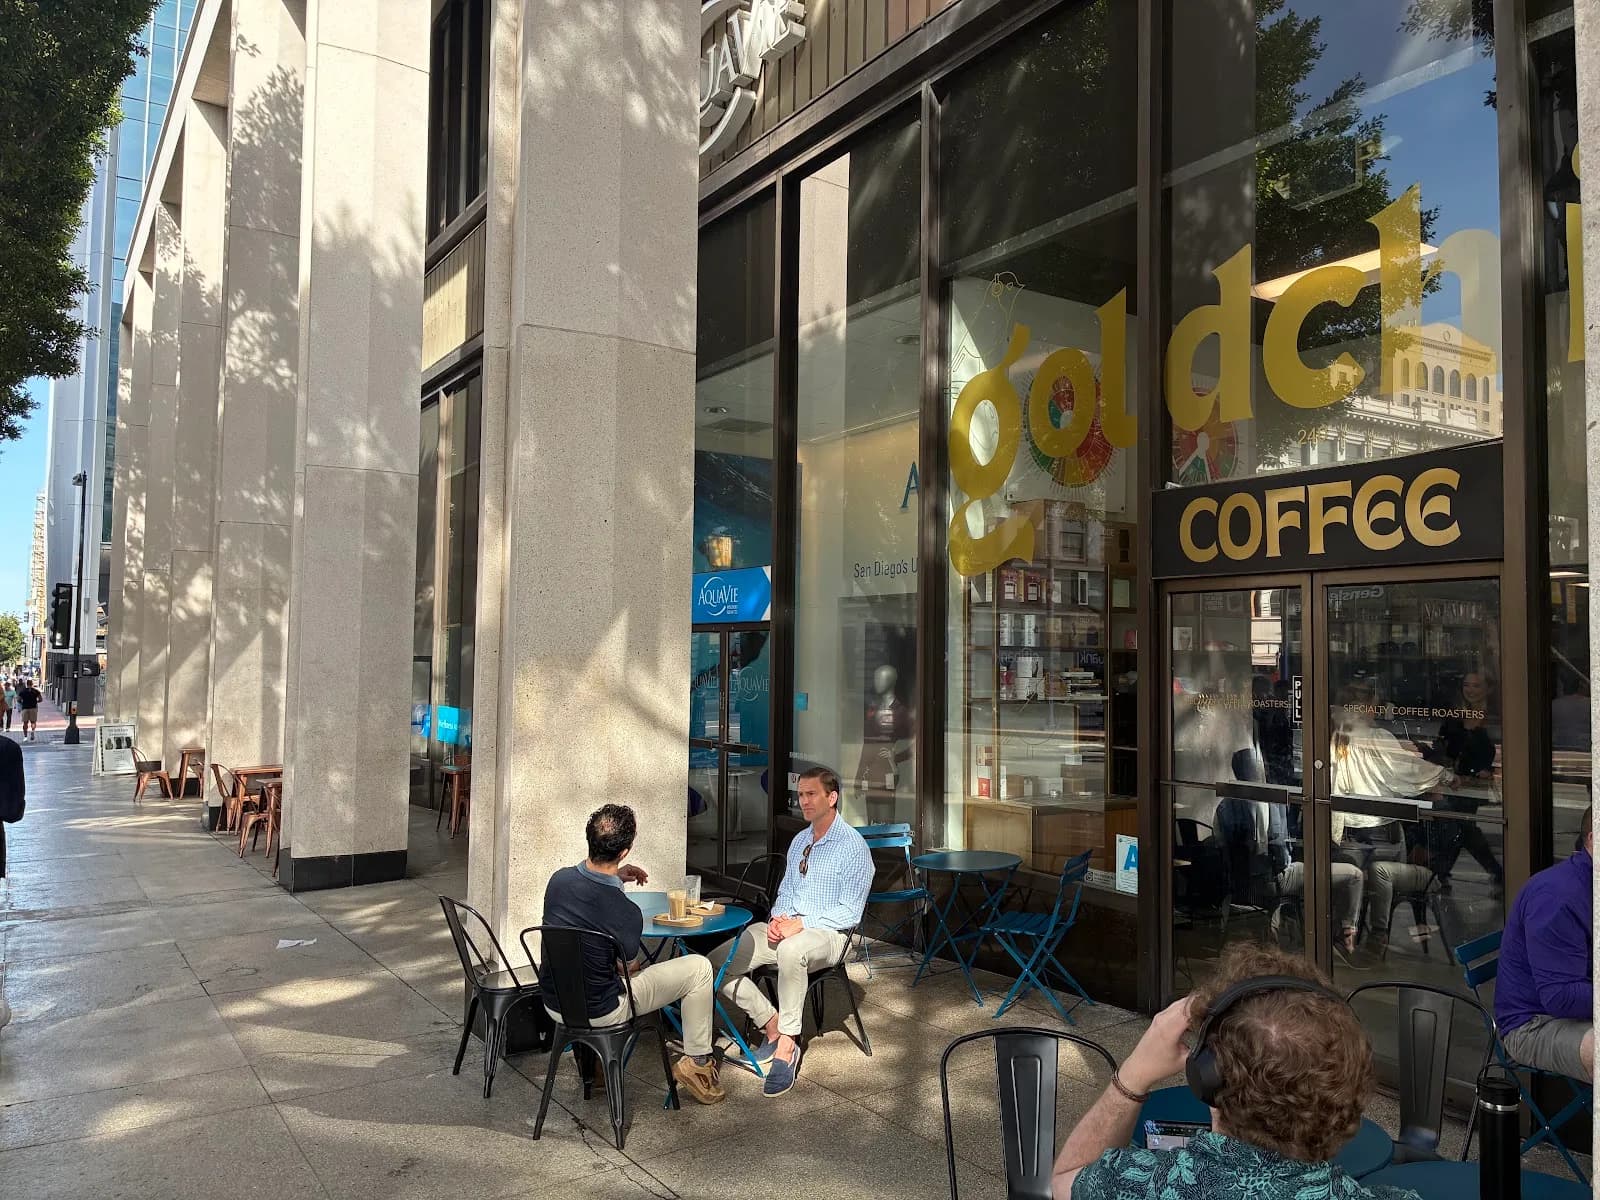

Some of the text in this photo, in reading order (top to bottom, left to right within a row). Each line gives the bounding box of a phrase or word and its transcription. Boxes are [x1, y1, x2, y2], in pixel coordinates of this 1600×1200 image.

[1179, 467, 1462, 563] COFFEE
[854, 563, 871, 578] San
[875, 560, 908, 578] Diego's
[1294, 680, 1303, 718] PULL
[1343, 704, 1485, 720] SPECIALTY COFFEE ROASTERS
[1123, 844, 1138, 870] A
